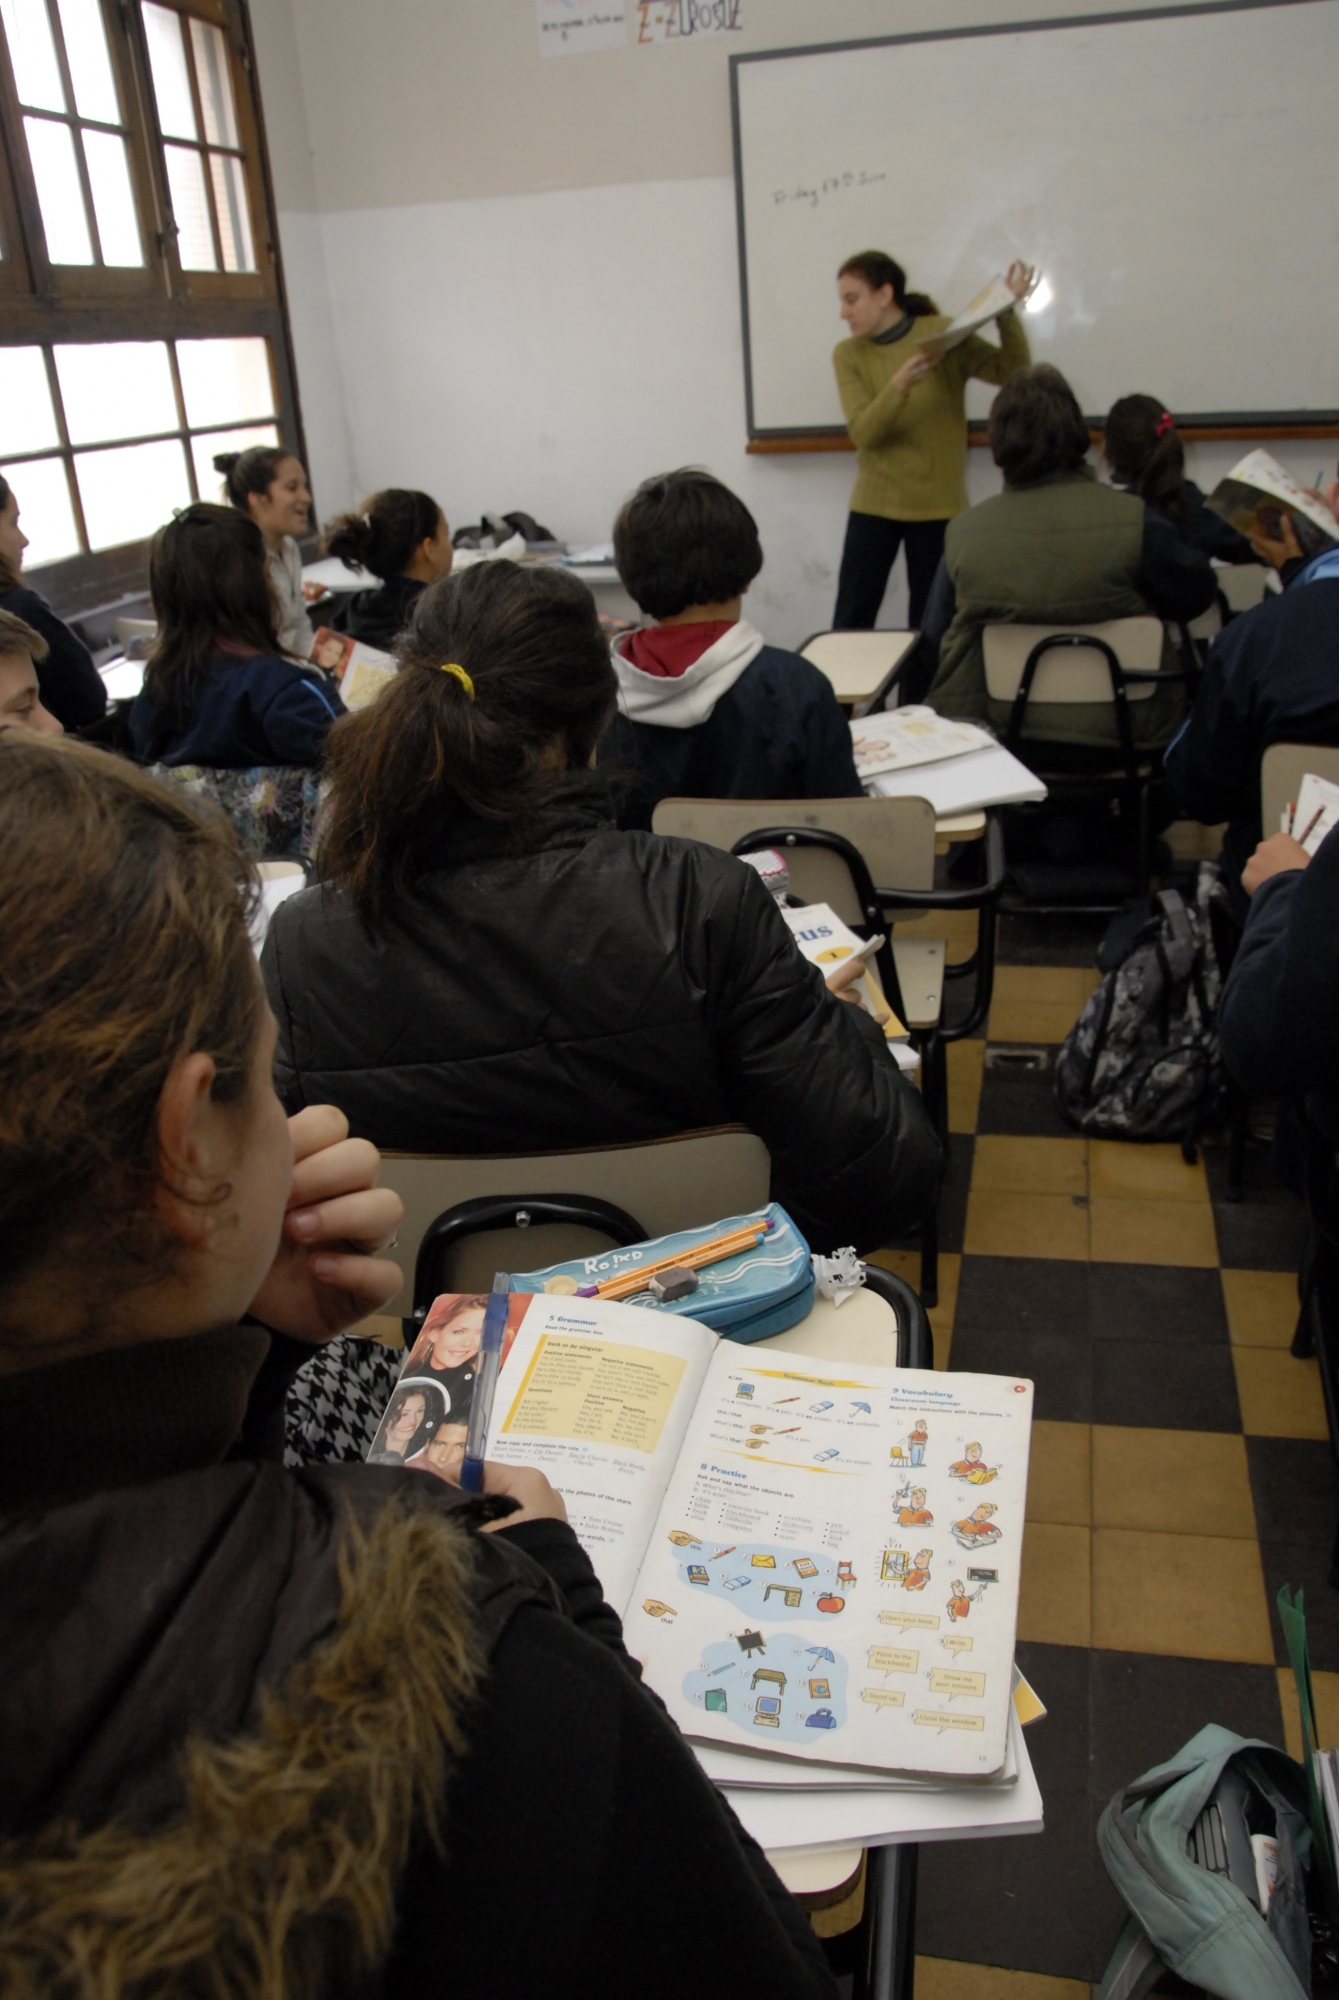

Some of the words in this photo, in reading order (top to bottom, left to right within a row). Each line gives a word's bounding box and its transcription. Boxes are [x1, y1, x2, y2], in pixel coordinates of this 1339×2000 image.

[549, 1314, 555, 1322] 5
[557, 1316, 598, 1326] Grammar
[579, 1344, 604, 1352] singular
[601, 1357, 624, 1365] Negative
[625, 1362, 654, 1371] statements
[783, 1373, 815, 1384] Grammar
[817, 1376, 835, 1386] flash
[901, 1388, 953, 1399] Vocabulary
[584, 1398, 605, 1406] Positive
[890, 1396, 927, 1404] Classroom
[928, 1399, 961, 1407] language
[622, 1405, 646, 1414] Negative
[919, 1406, 952, 1414] instructions
[700, 1462, 708, 1471] 8
[710, 1465, 748, 1480] Practice
[733, 1482, 749, 1490] what
[761, 1488, 783, 1496] objects
[576, 1490, 596, 1498] photos
[616, 1498, 633, 1506] stars.
[696, 1496, 712, 1504] chair
[694, 1502, 710, 1510] table
[727, 1503, 753, 1513] exercise
[754, 1508, 769, 1516] book
[692, 1508, 707, 1516] book
[726, 1508, 761, 1521] blackboard
[589, 1515, 602, 1523] Tom
[603, 1519, 624, 1528] Cruise
[724, 1515, 753, 1526] umbrella
[782, 1520, 814, 1532] dictionary
[584, 1522, 599, 1531] Julia
[600, 1525, 625, 1536] Roberts
[722, 1521, 753, 1532] computer
[586, 1534, 607, 1542] words.
[689, 1543, 702, 1552] this
[660, 1616, 674, 1625] that
[885, 1614, 902, 1622] Open
[874, 1658, 911, 1668] blackboard.
[943, 1673, 961, 1681] Show
[934, 1681, 950, 1689] your
[951, 1682, 979, 1691] scissors.
[868, 1692, 888, 1700] Stand
[919, 1714, 938, 1722] Close
[951, 1717, 979, 1726] window.
